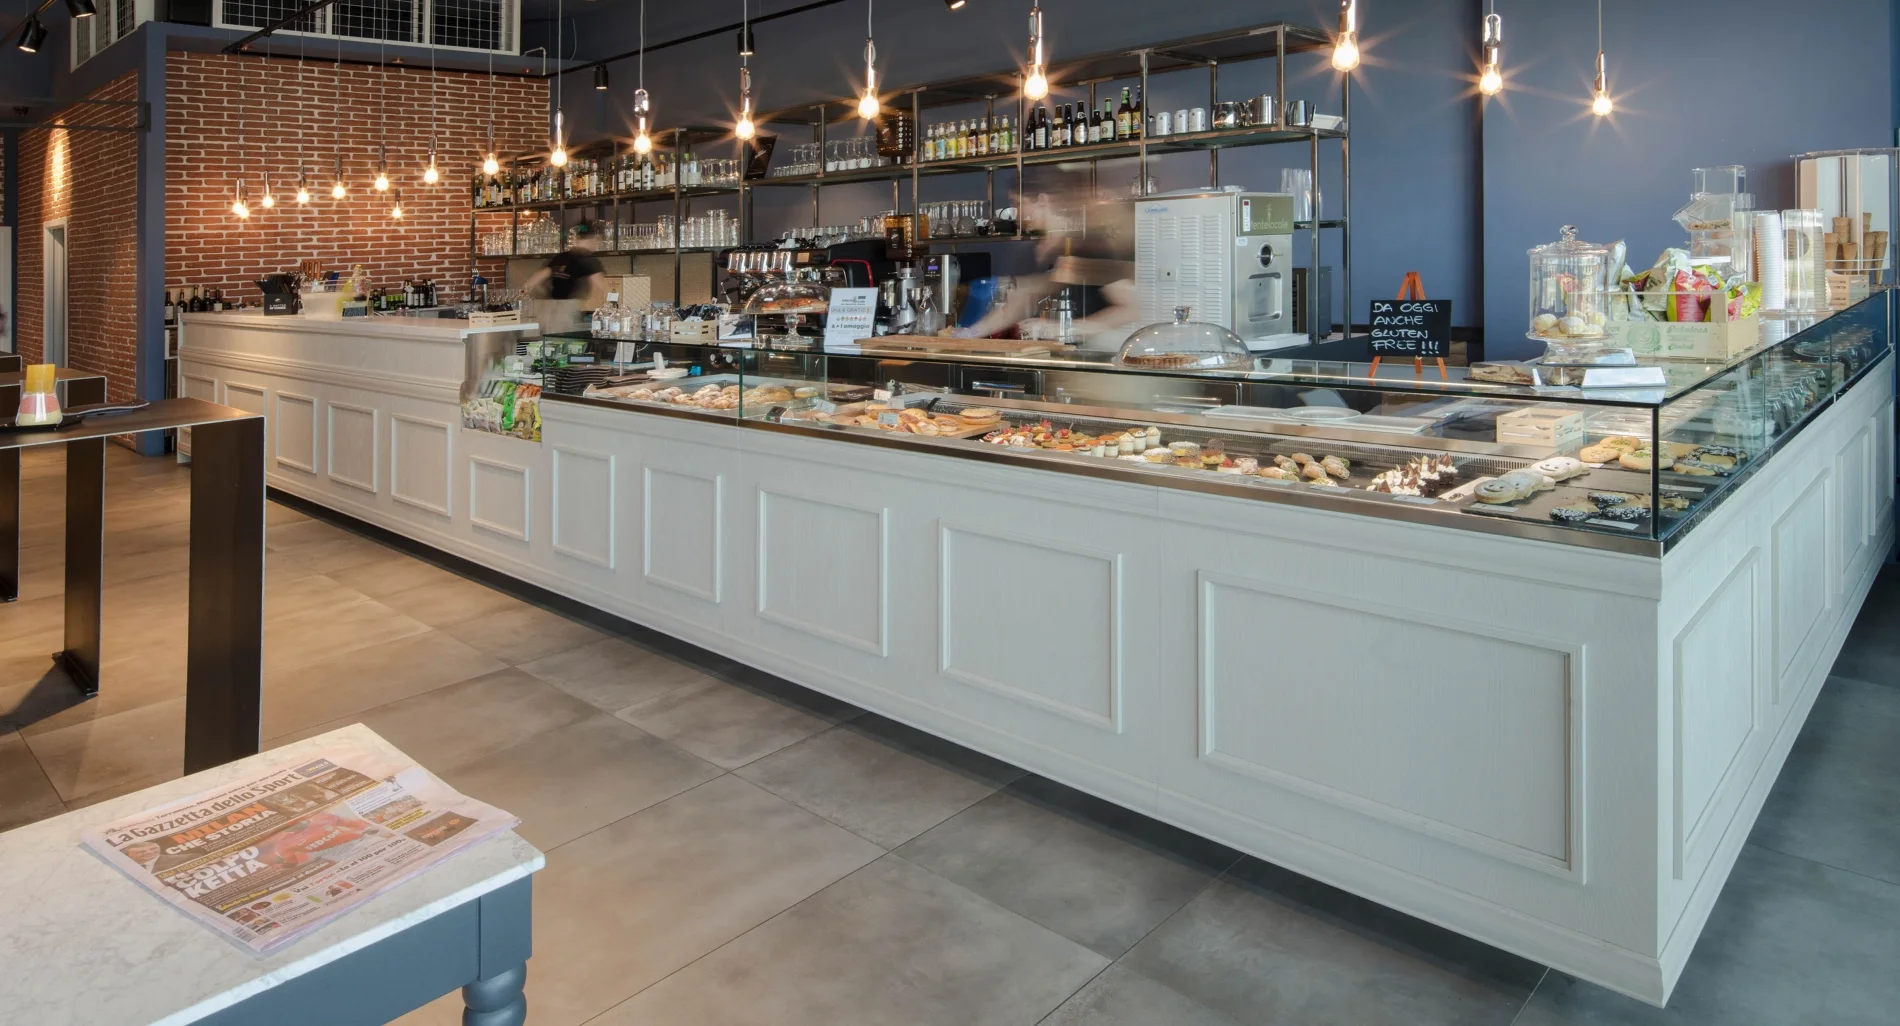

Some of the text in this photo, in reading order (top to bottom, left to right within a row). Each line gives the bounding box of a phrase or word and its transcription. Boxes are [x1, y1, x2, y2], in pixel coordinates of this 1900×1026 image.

[1373, 303, 1439, 313] DA OGGI
[1373, 315, 1424, 326] ANCHE
[1371, 328, 1428, 339] GLUTEN
[105, 832, 134, 848] La
[131, 807, 214, 838] Gazzetta
[210, 789, 256, 812] dello
[251, 772, 304, 795] Sport
[170, 801, 271, 845] MILAN
[165, 838, 207, 855] CHE
[204, 810, 278, 841] STORIA
[176, 845, 260, 889] COLPO
[183, 858, 269, 898] KEITA
